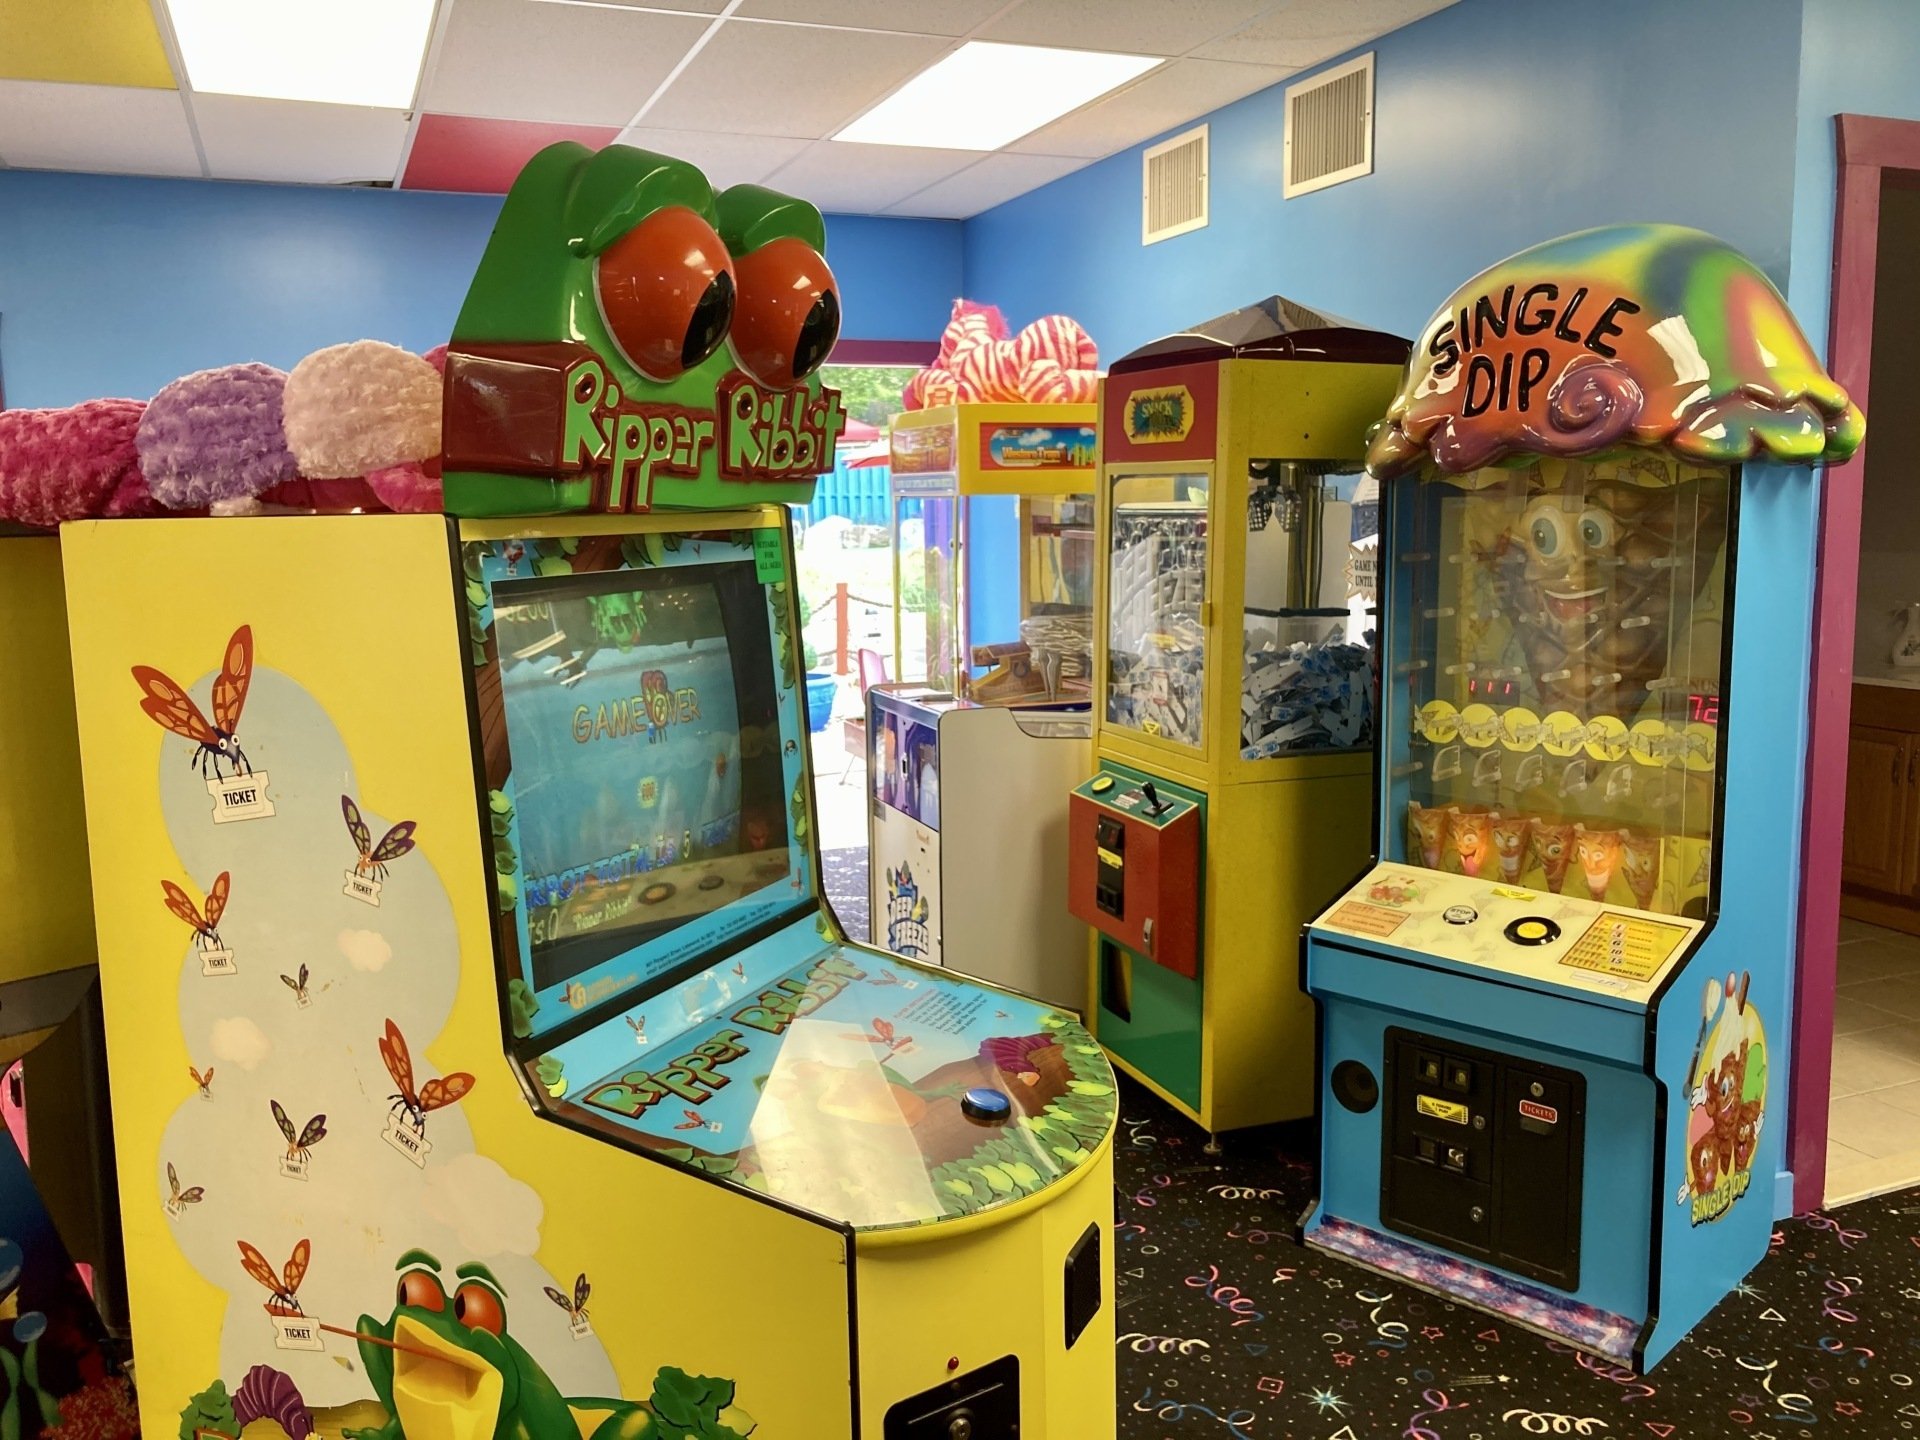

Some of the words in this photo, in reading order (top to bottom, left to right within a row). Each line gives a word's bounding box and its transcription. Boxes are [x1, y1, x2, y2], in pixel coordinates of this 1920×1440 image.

[1429, 282, 1641, 376] SINGLE
[1461, 347, 1550, 418] DIP
[560, 358, 715, 510] Ripper
[725, 382, 845, 472] Ribbit
[1354, 560, 1371, 571] GAME
[1355, 575, 1373, 587] UNTIL
[572, 694, 647, 744] GAME
[652, 687, 702, 730] OVER
[1688, 695, 1719, 724] 72
[222, 788, 258, 806] TICKET
[353, 881, 373, 896] TICKET
[208, 958, 228, 968] TICKET
[583, 1029, 750, 1119] Ripper
[731, 952, 868, 1035] Ribbit
[1523, 1103, 1554, 1119] TICKETS
[395, 1129, 419, 1153] TICKET
[1691, 1181, 1731, 1224] SINGLE
[1731, 1171, 1751, 1199] DIP
[284, 1327, 311, 1339] TICKET
